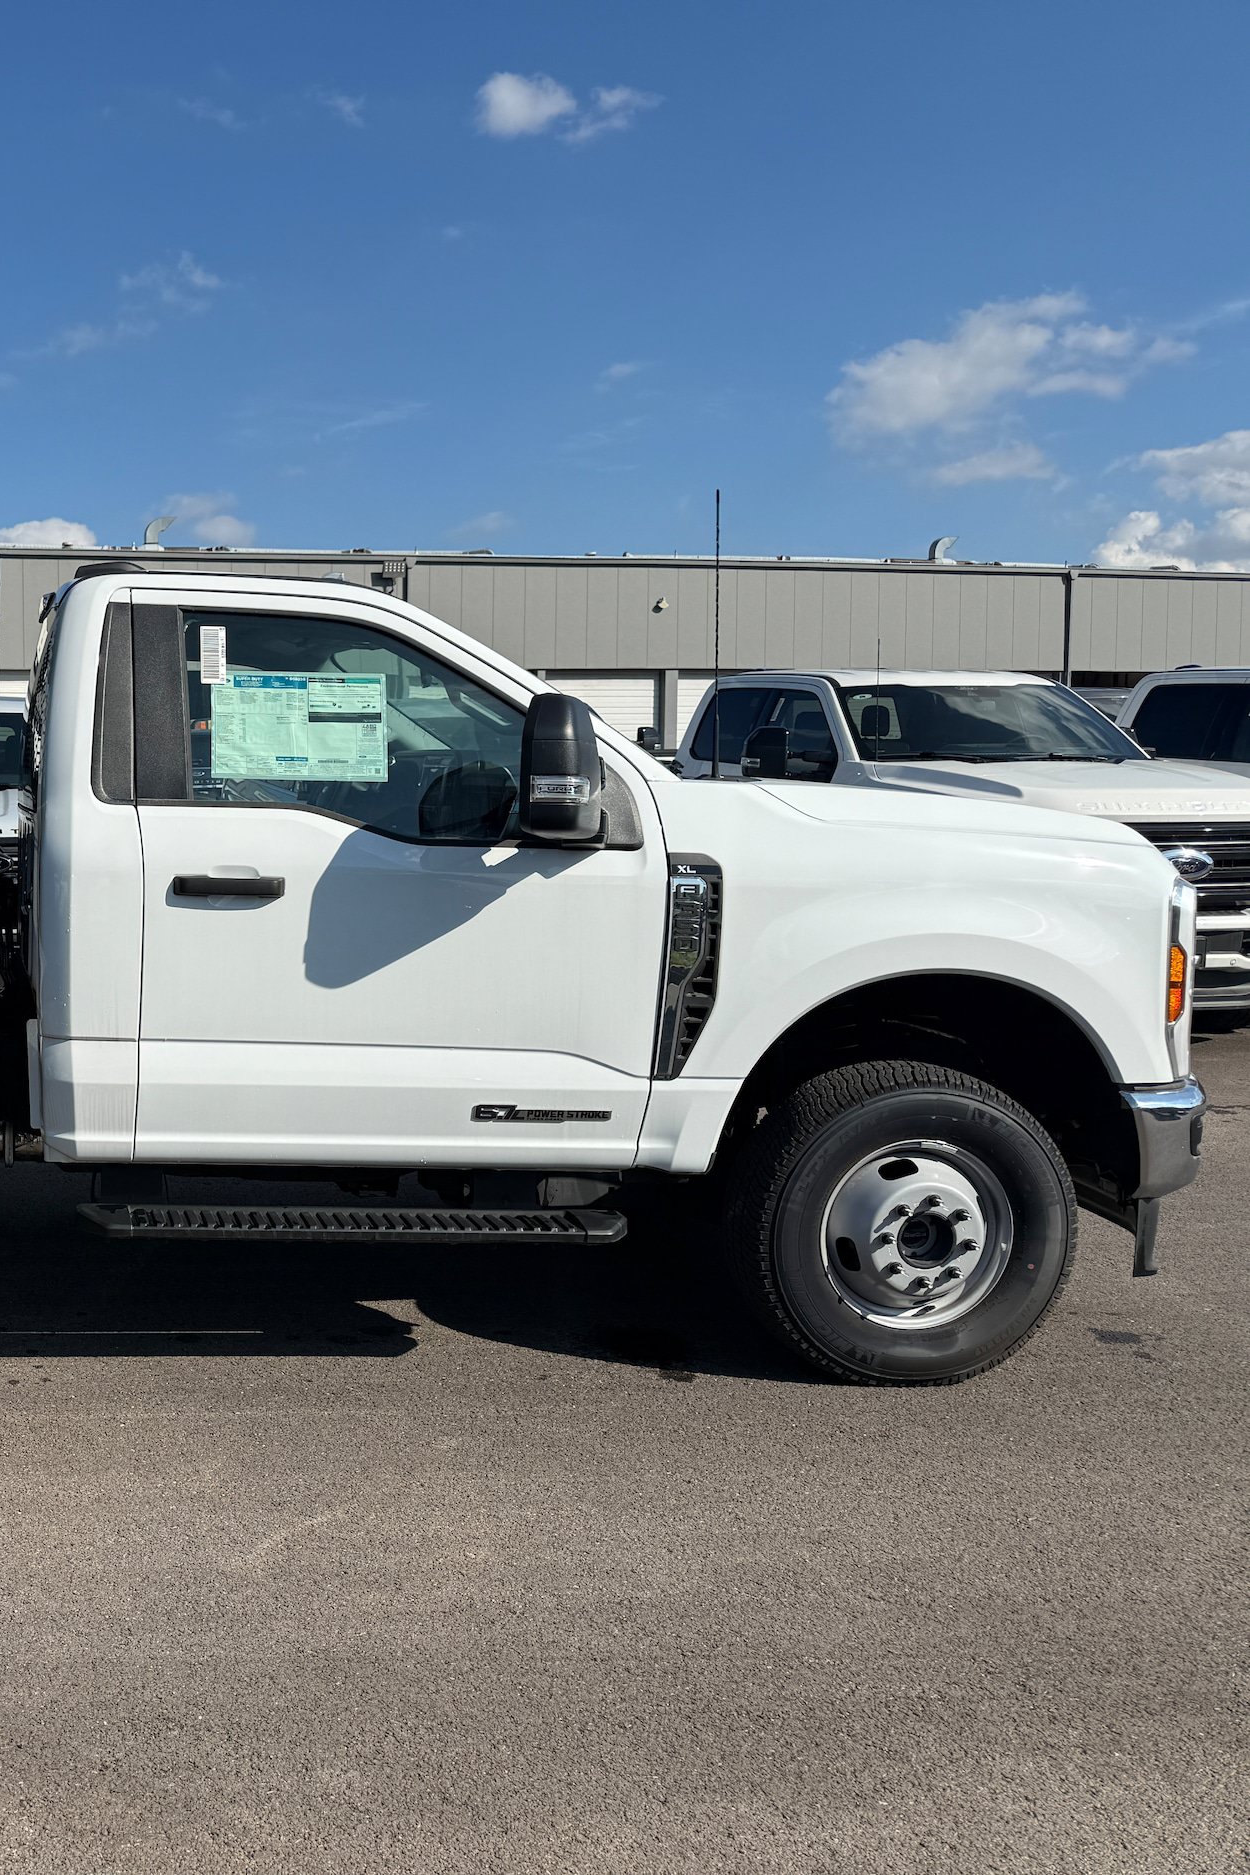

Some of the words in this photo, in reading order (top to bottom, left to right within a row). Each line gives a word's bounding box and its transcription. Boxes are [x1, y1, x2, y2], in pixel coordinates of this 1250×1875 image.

[677, 865, 697, 874] XL
[527, 1110, 564, 1119] POWER
[566, 1110, 609, 1119] STROKE
